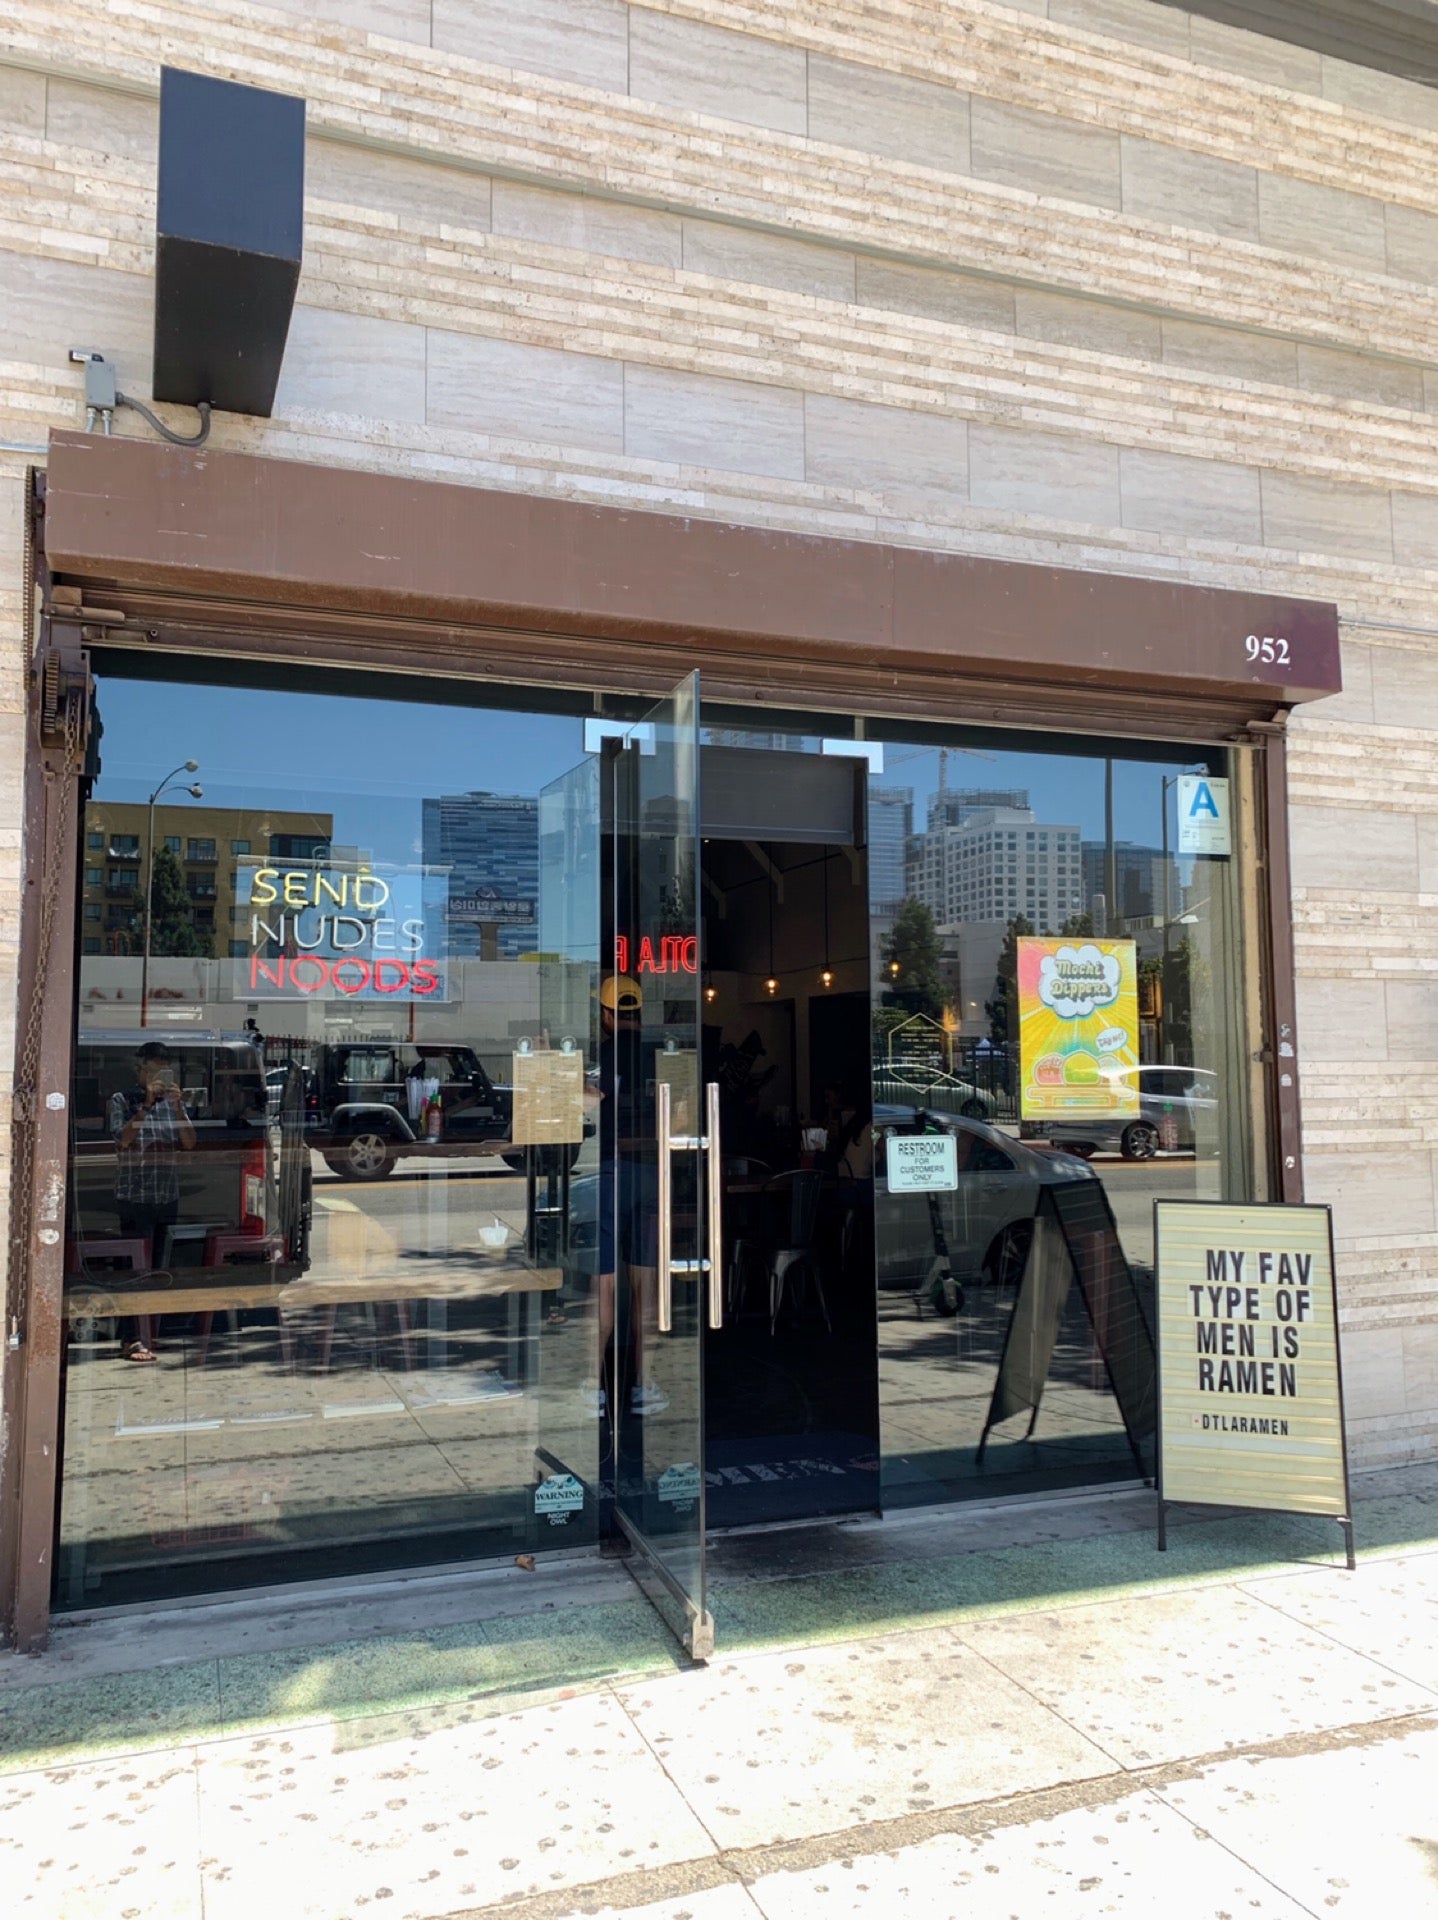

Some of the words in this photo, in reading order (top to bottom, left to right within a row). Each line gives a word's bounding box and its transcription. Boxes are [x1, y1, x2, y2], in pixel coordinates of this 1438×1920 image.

[1245, 635, 1291, 665] 952
[1189, 781, 1219, 818] A
[251, 868, 390, 909] SEND
[251, 913, 425, 951] NUDES
[250, 954, 438, 995] NOODS
[898, 1141, 945, 1156] RESTROOM
[914, 1157, 930, 1165] FOR
[900, 1165, 945, 1174] CUSTOMERS
[1207, 1249, 1246, 1283] MY
[1259, 1252, 1312, 1286] FAV
[1189, 1284, 1260, 1321] TYPE
[1276, 1289, 1311, 1323] OF
[1196, 1321, 1255, 1358] MEN
[1272, 1325, 1299, 1359] IS
[1199, 1358, 1297, 1398] RAMEN
[535, 1490, 583, 1500] WARNING
[547, 1511, 570, 1519] NIGHT
[550, 1518, 568, 1526] OWL
